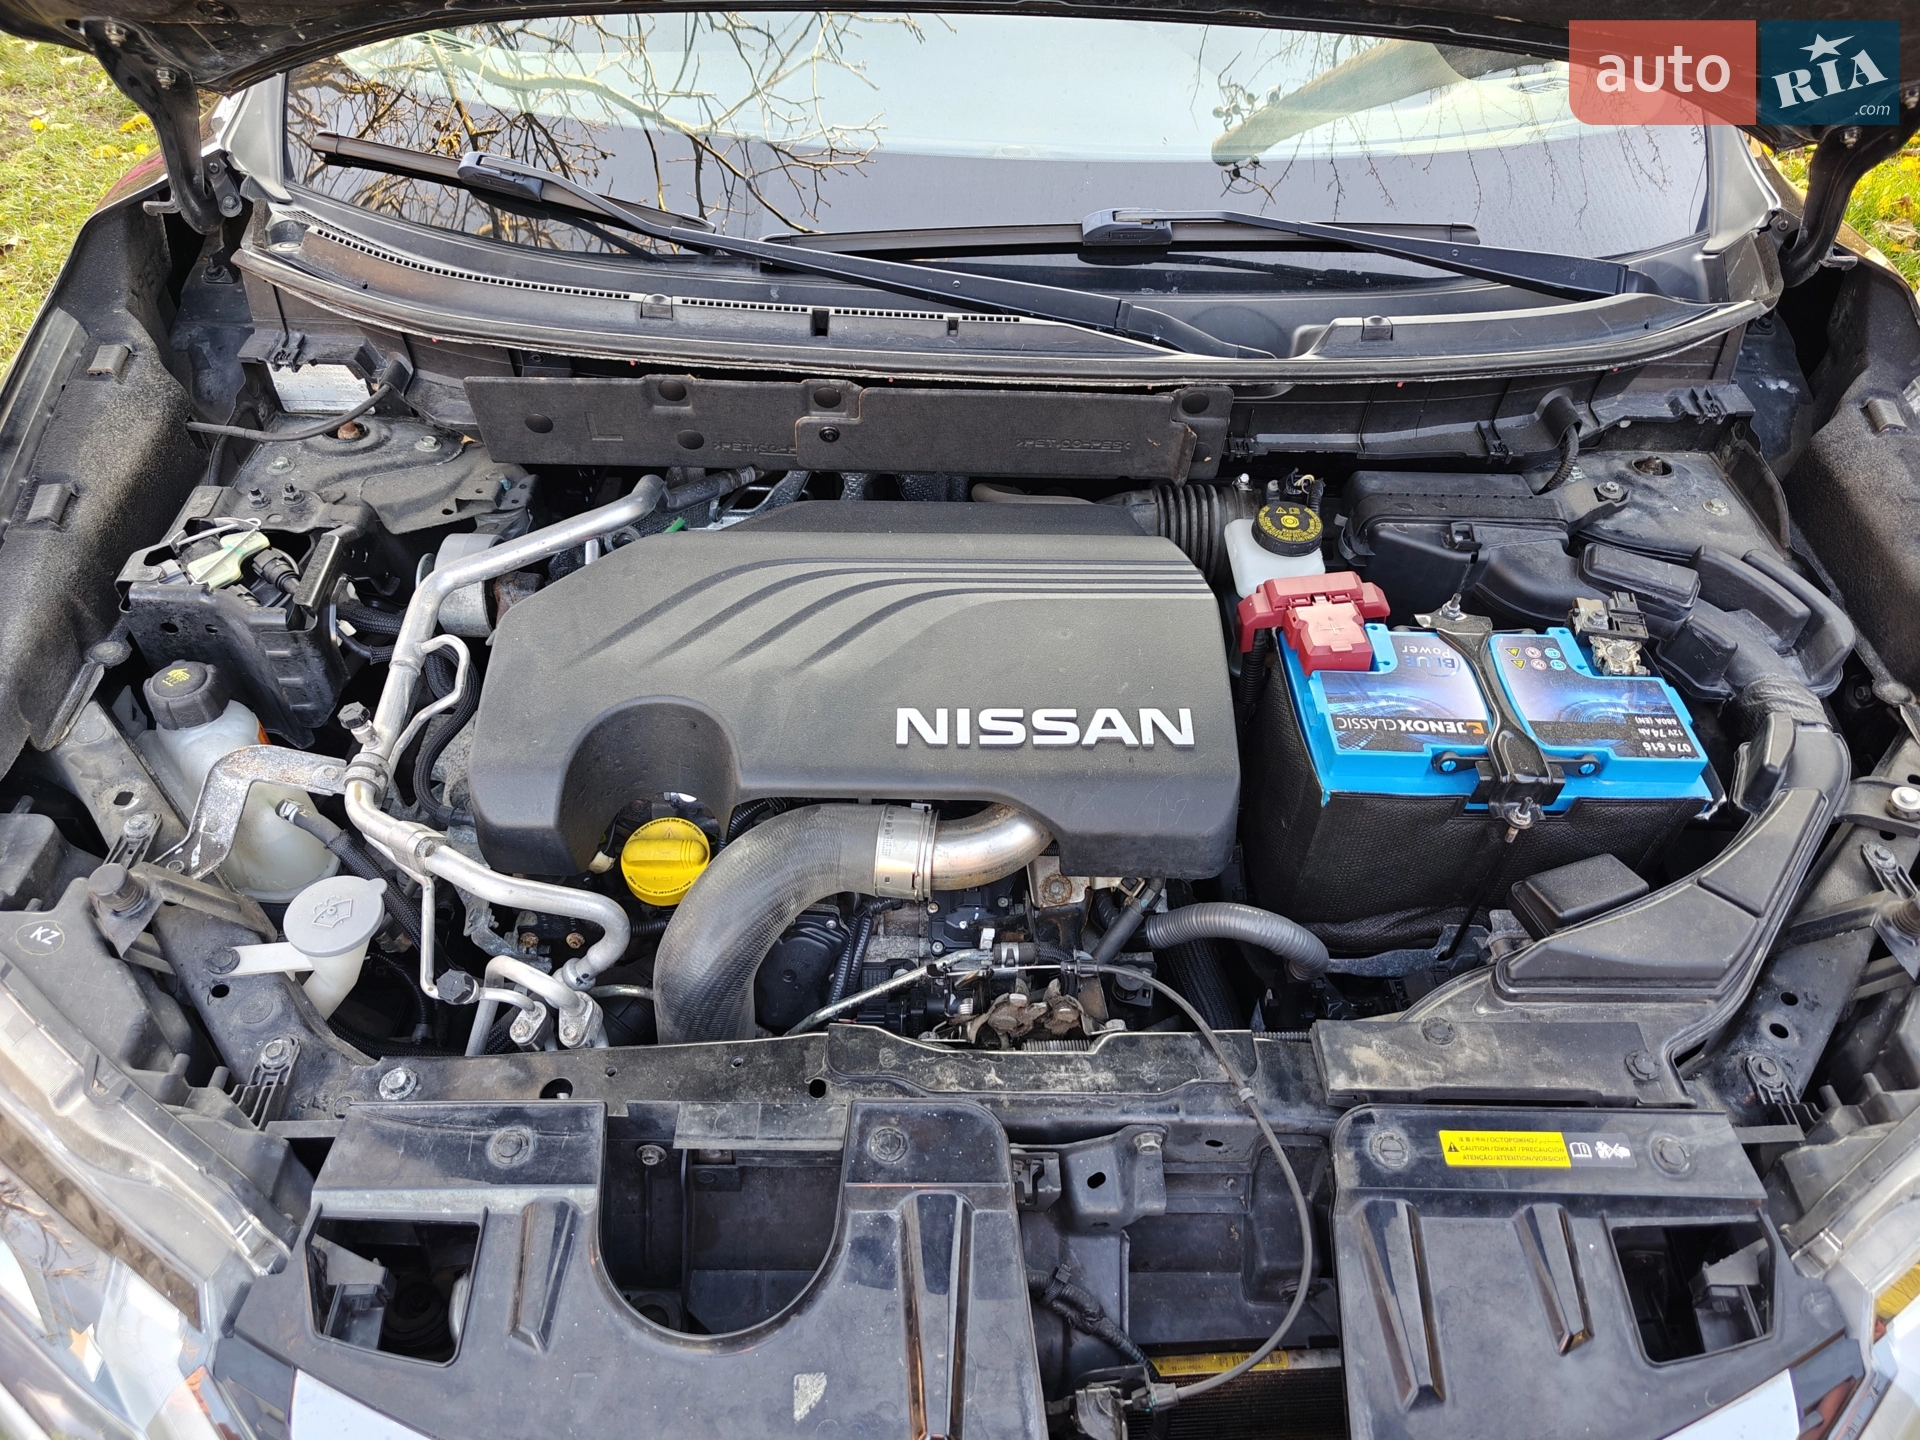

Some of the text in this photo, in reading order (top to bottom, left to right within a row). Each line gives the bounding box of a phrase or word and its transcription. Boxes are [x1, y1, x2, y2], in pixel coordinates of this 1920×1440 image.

[1402, 645, 1451, 658] Power
[1405, 655, 1455, 668] BLUE
[1635, 716, 1677, 725] 680A (EN)
[895, 707, 1195, 747] NISSAN
[1668, 729, 1684, 737] 12V
[1642, 741, 1692, 752] 074 616
[650, 818, 670, 826] exceed
